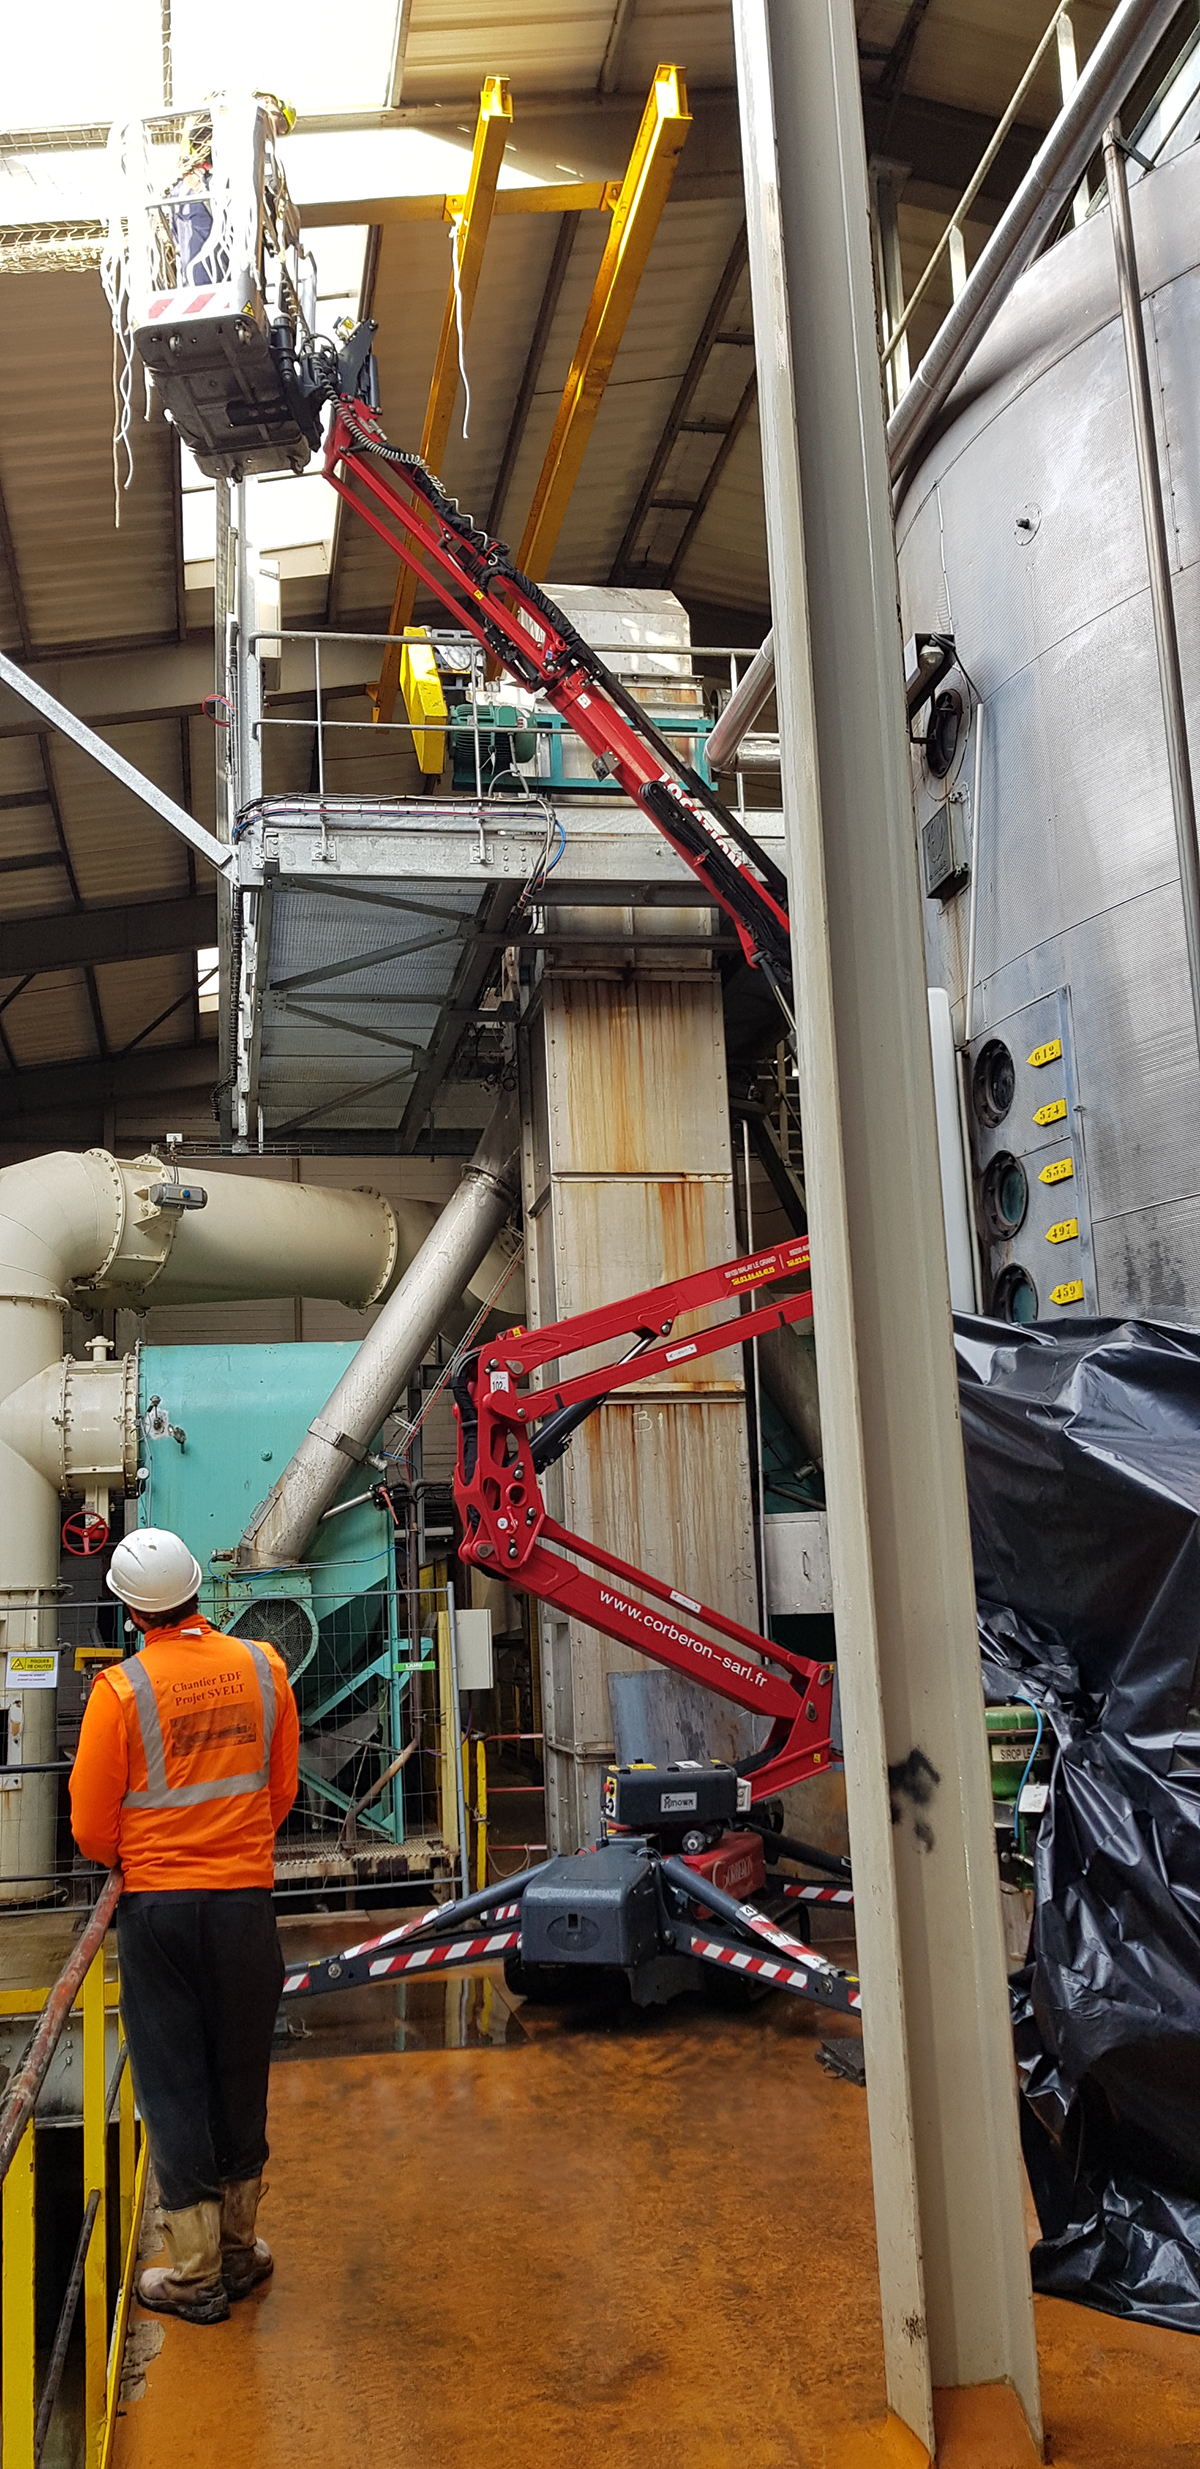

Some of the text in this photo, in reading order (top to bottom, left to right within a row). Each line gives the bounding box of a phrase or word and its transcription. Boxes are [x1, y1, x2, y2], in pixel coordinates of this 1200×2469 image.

[1040, 1105, 1060, 1120] 574
[1052, 1223, 1071, 1239] 497
[1056, 1285, 1076, 1300] 459
[600, 1590, 768, 1688] www.corberon-sarl.fr
[172, 1671, 242, 1694] Chantier EDF
[175, 1683, 245, 1707] Projet SVELT
[1000, 1748, 1021, 1760] SIROP
